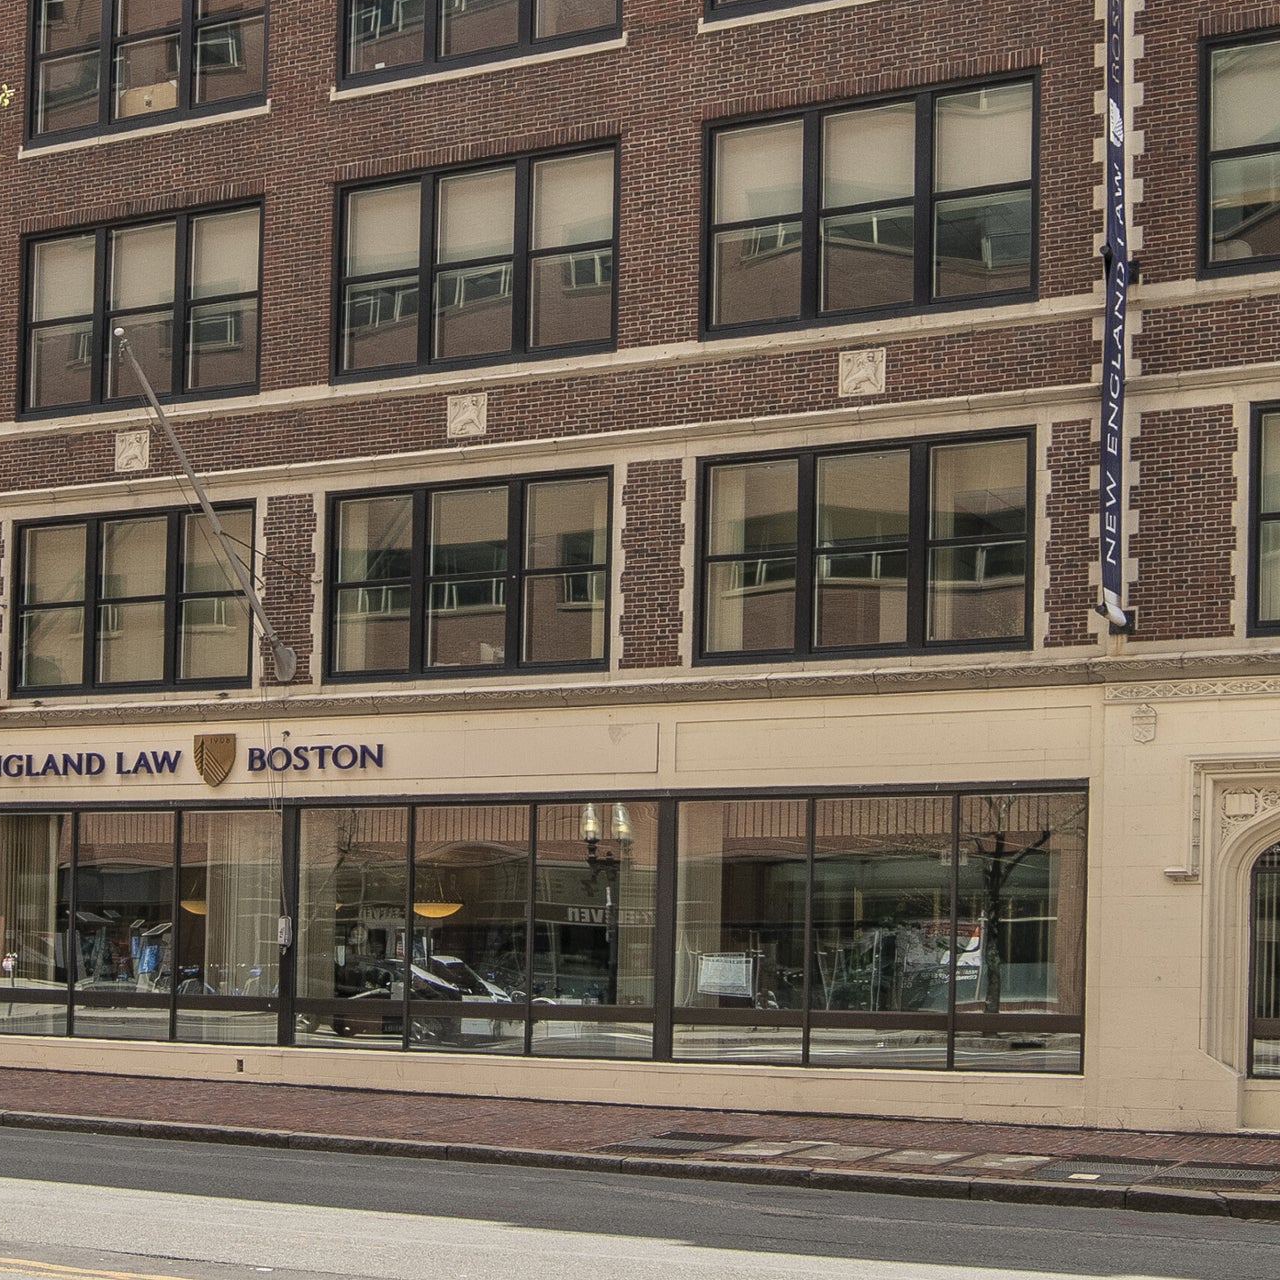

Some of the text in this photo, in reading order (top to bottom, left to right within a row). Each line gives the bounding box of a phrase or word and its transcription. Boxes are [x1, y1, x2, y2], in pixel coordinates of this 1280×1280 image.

[1106, 261, 1126, 456] ENGLAND
[1105, 470, 1117, 565] NEW
[116, 750, 182, 775] LAW
[247, 744, 385, 771] BOSTON
[209, 737, 231, 745] 1908
